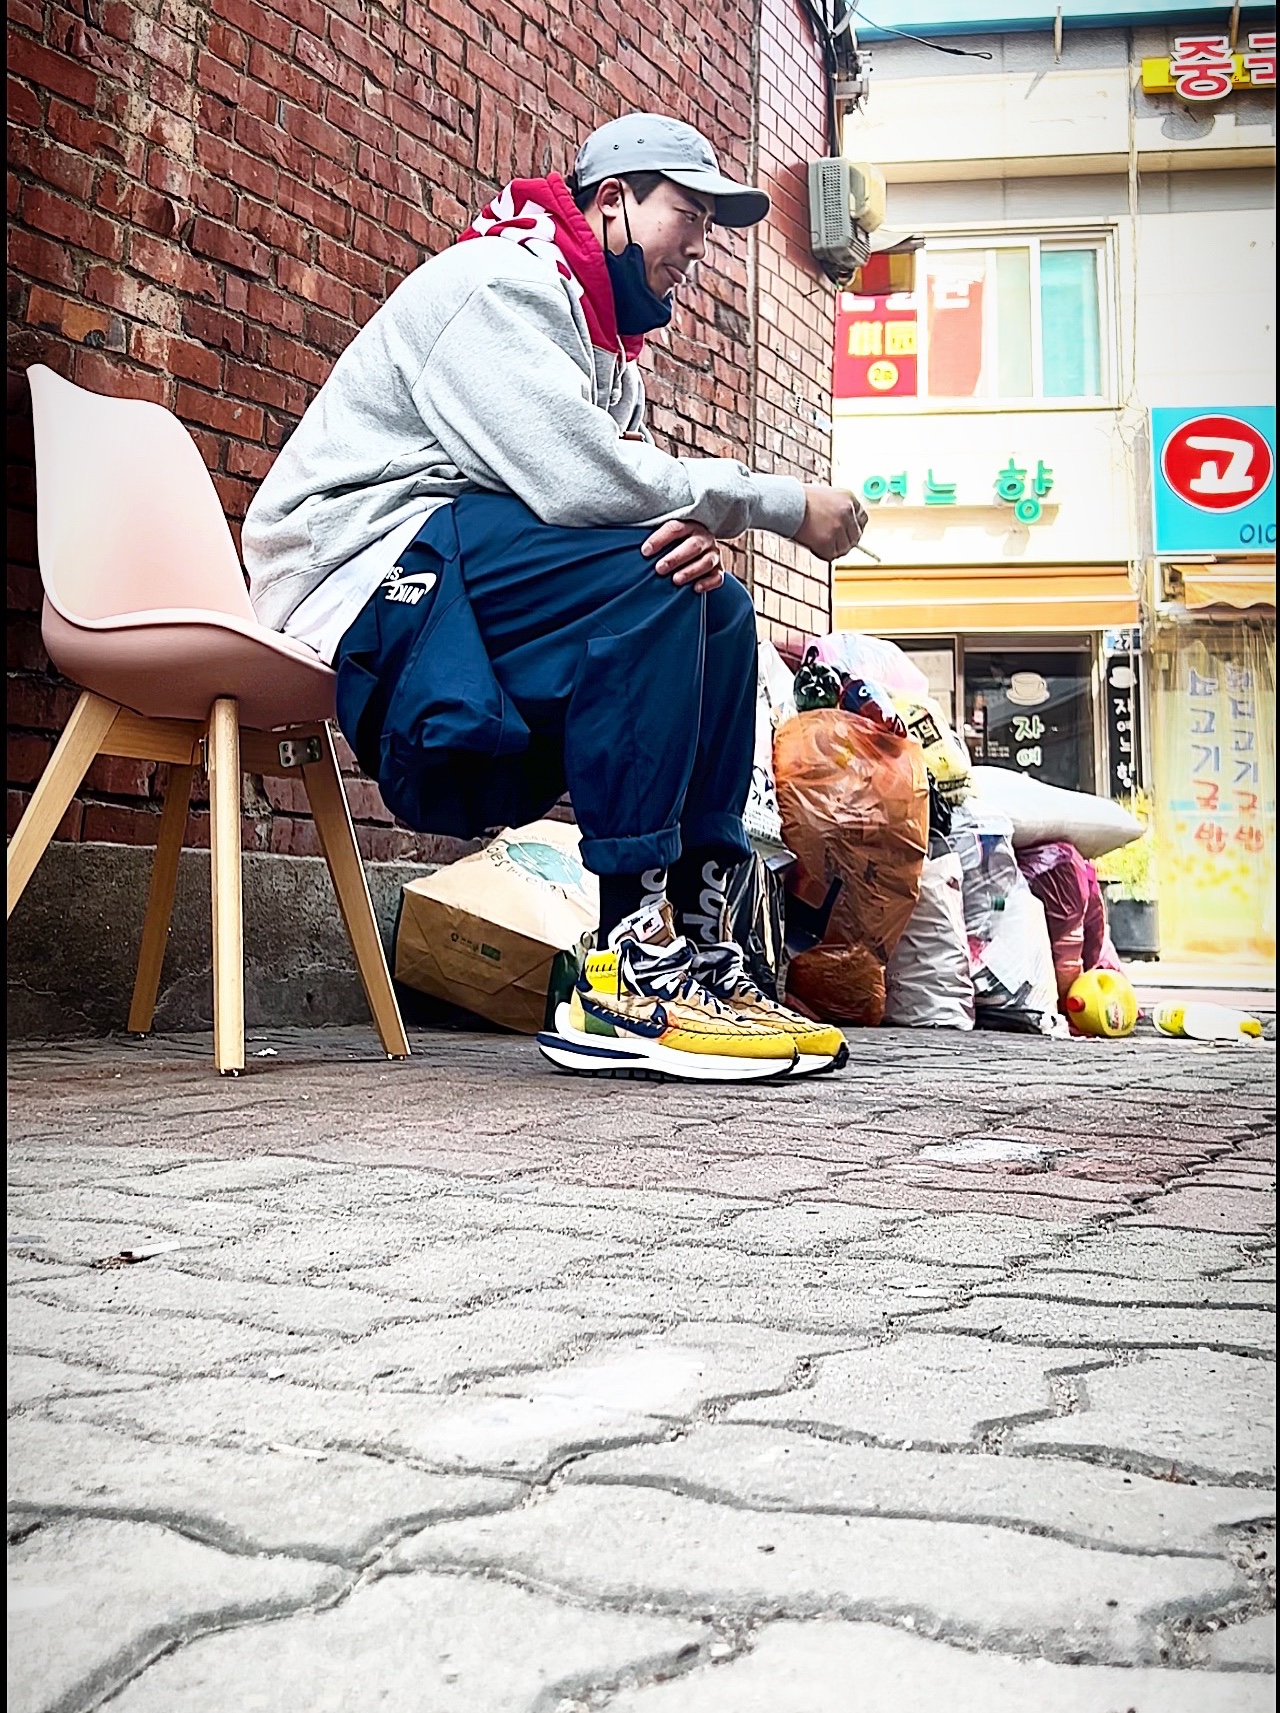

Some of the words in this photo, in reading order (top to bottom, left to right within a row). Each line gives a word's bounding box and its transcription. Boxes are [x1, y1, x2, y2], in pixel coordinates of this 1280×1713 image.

[1185, 435, 1254, 494] 고
[384, 584, 425, 605] NIKE
[1012, 714, 1046, 776] 자여
